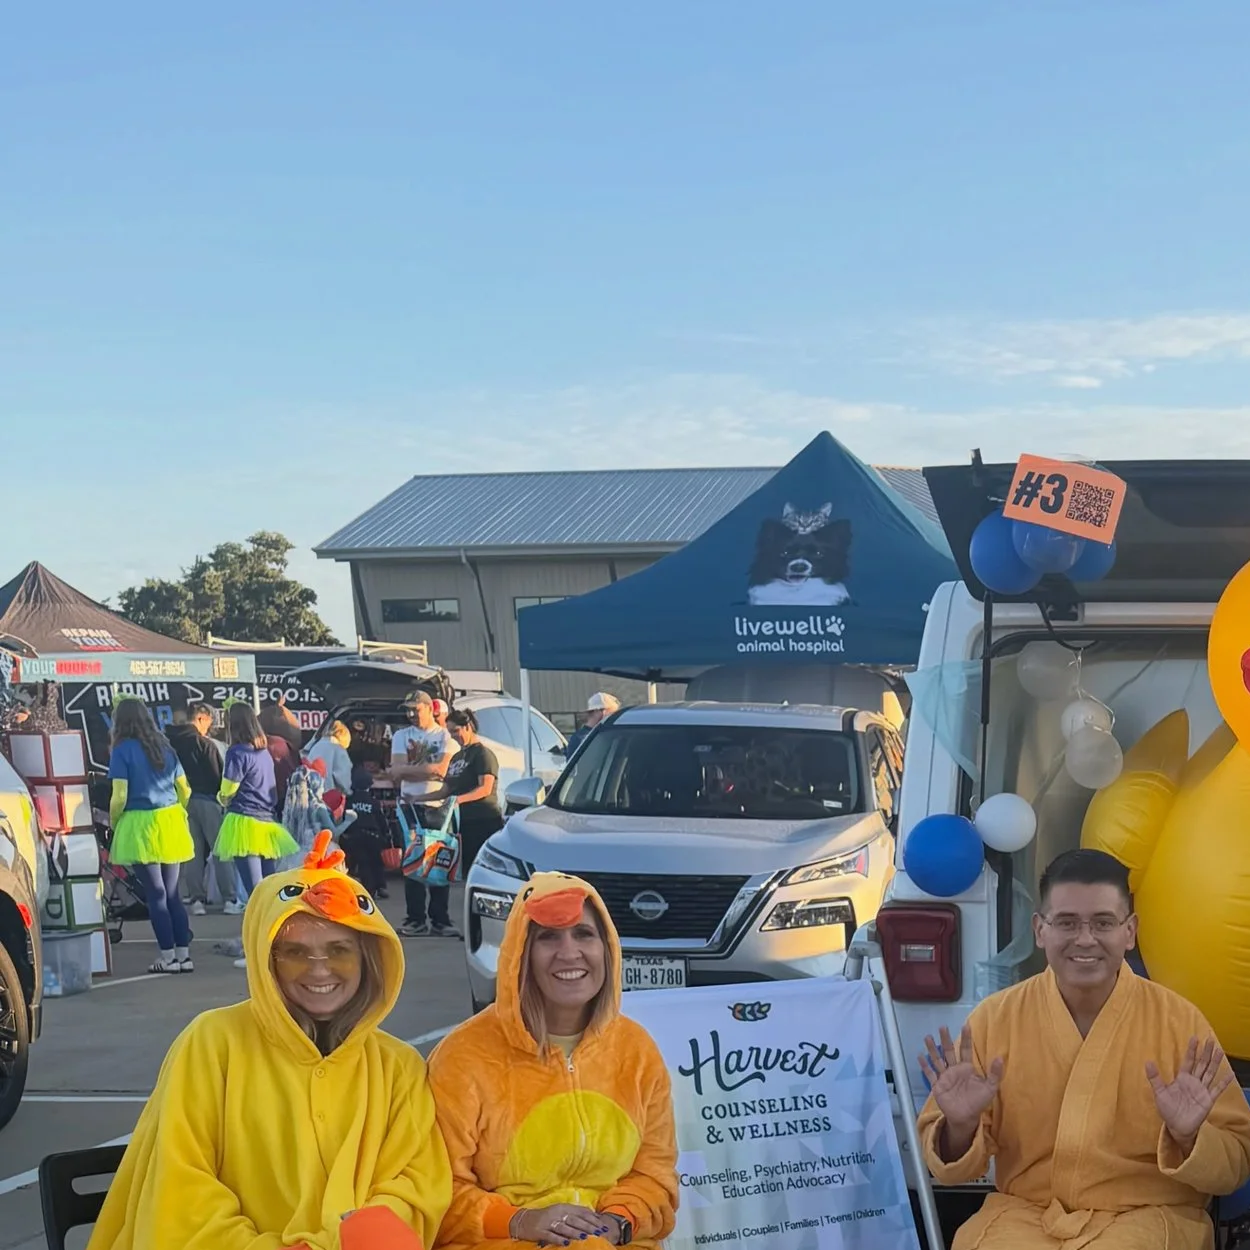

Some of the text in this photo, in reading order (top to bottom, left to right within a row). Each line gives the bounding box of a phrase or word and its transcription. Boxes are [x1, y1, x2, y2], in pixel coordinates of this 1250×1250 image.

[1012, 471, 1069, 514] #3
[734, 616, 825, 636] livewell
[736, 638, 845, 655] animal hospital
[259, 673, 285, 683] TEXT
[636, 957, 664, 966] TEXAS
[678, 1030, 840, 1096] Harvest
[701, 1093, 828, 1120] COUNSELING
[706, 1116, 832, 1144] & WELLNESS
[680, 1150, 876, 1187] Counseling, Psychiatry, Nutrition,
[722, 1172, 847, 1199] Education Advocacy
[742, 1224, 780, 1239] Couples
[784, 1217, 820, 1231] Families
[825, 1212, 853, 1225] Teens
